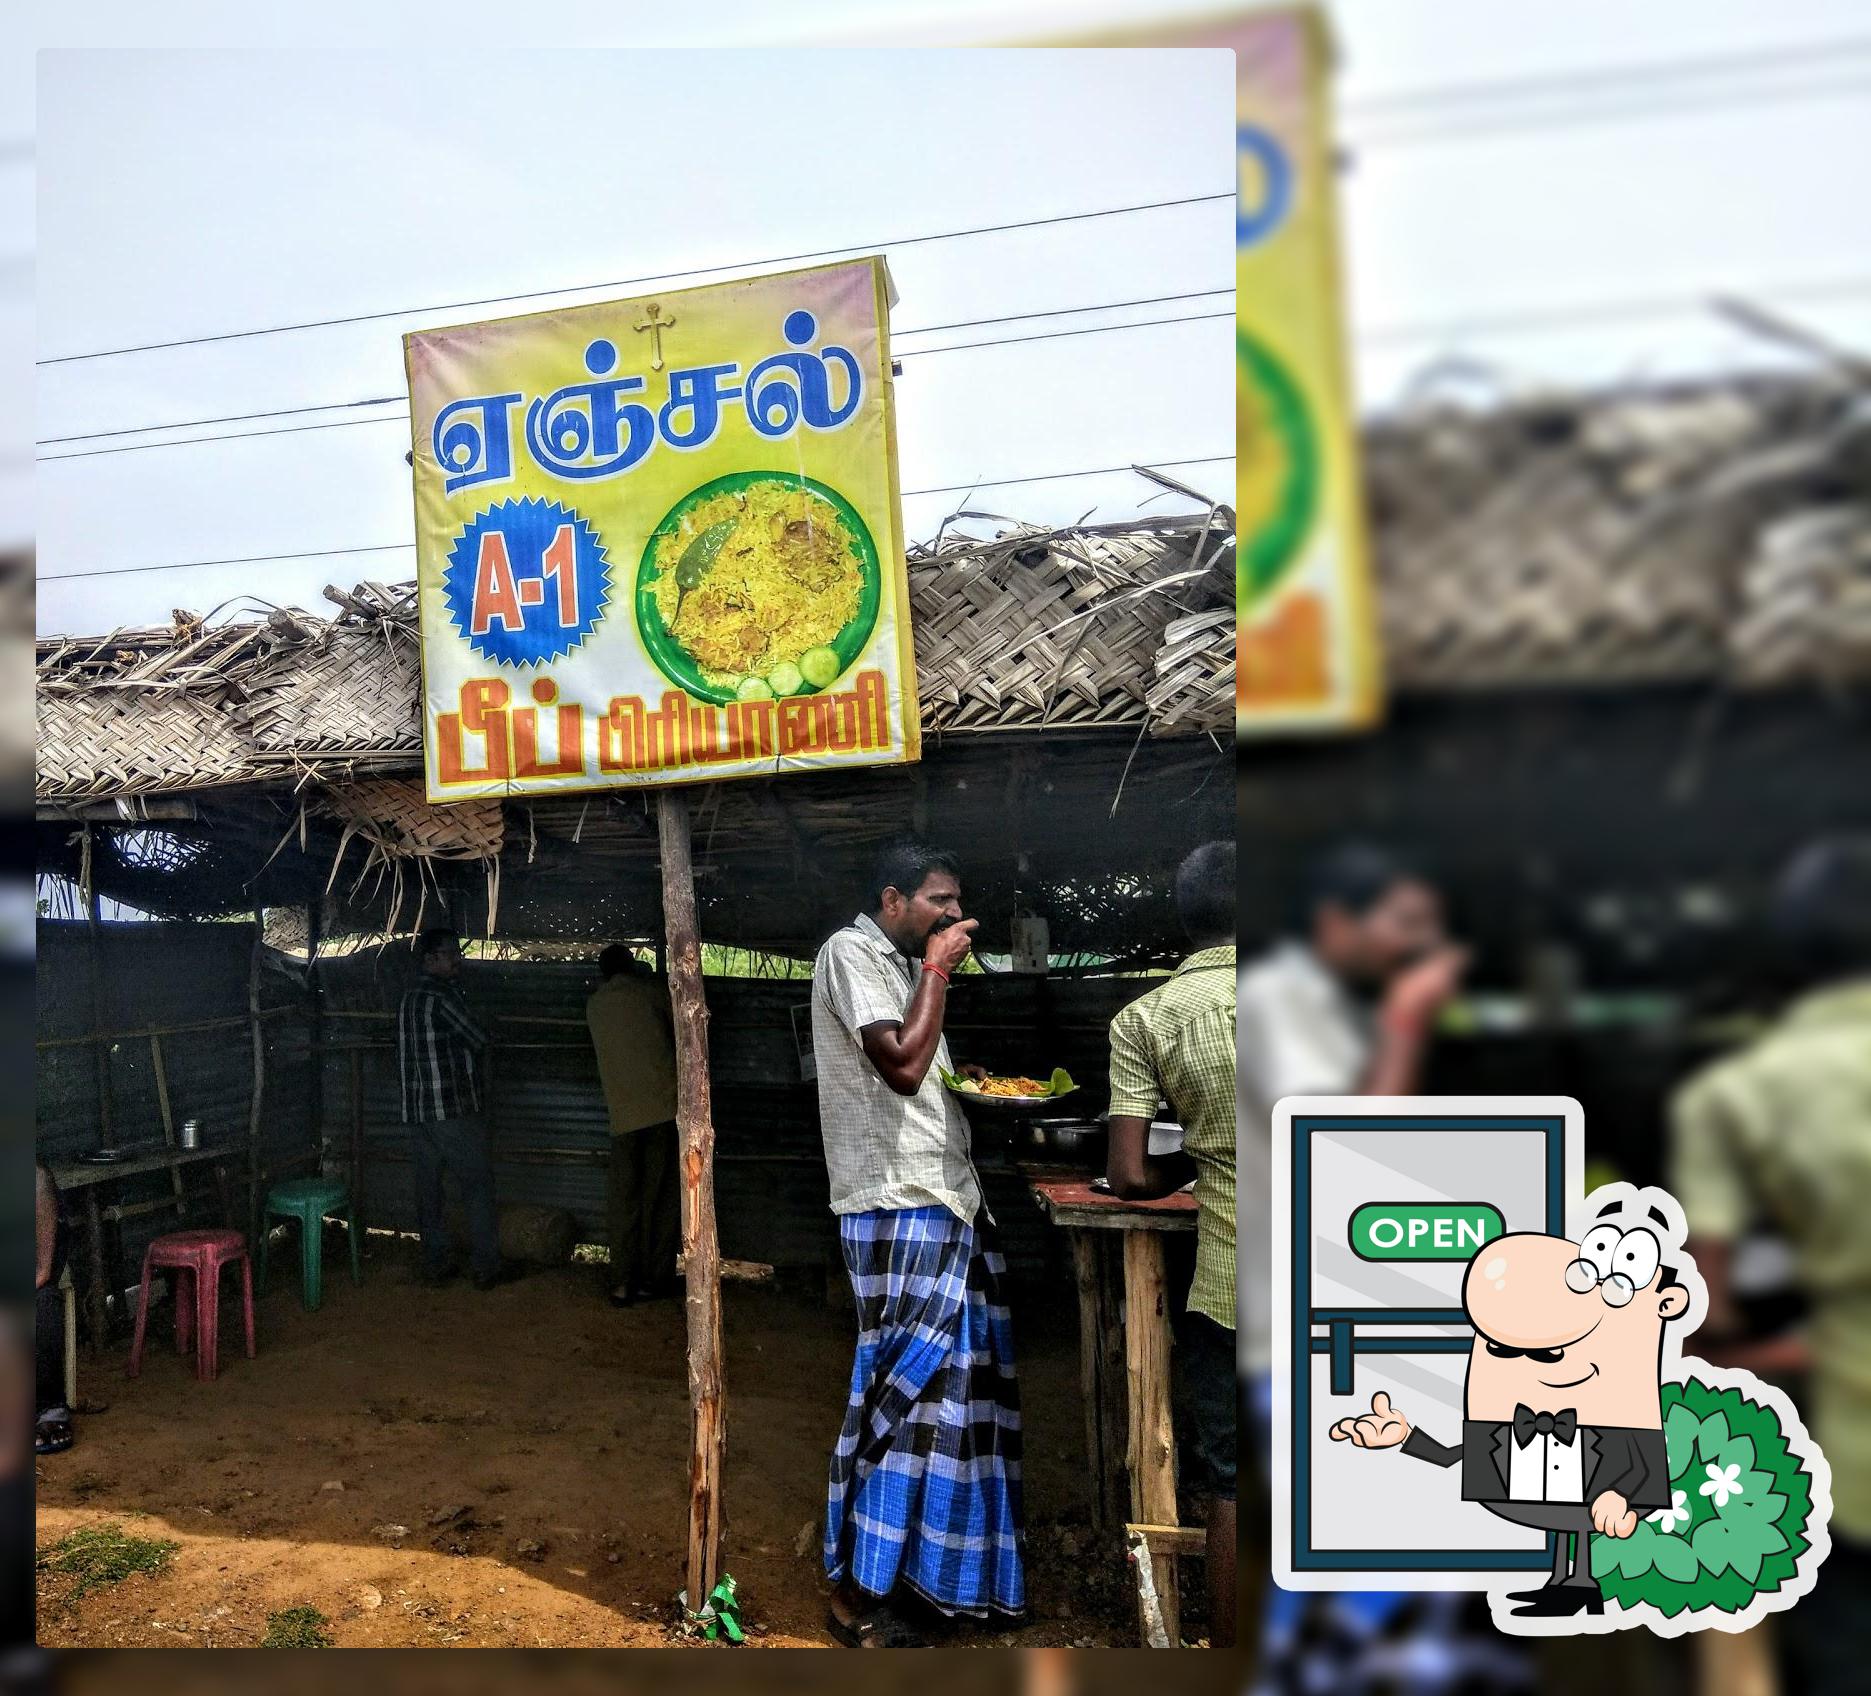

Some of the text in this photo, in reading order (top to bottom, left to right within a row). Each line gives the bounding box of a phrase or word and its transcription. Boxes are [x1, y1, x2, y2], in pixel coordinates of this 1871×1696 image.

[434, 310, 862, 494] ஏஞ்சல்
[472, 525, 579, 634] A-1
[437, 671, 889, 784] பீப் பிரியாணி
